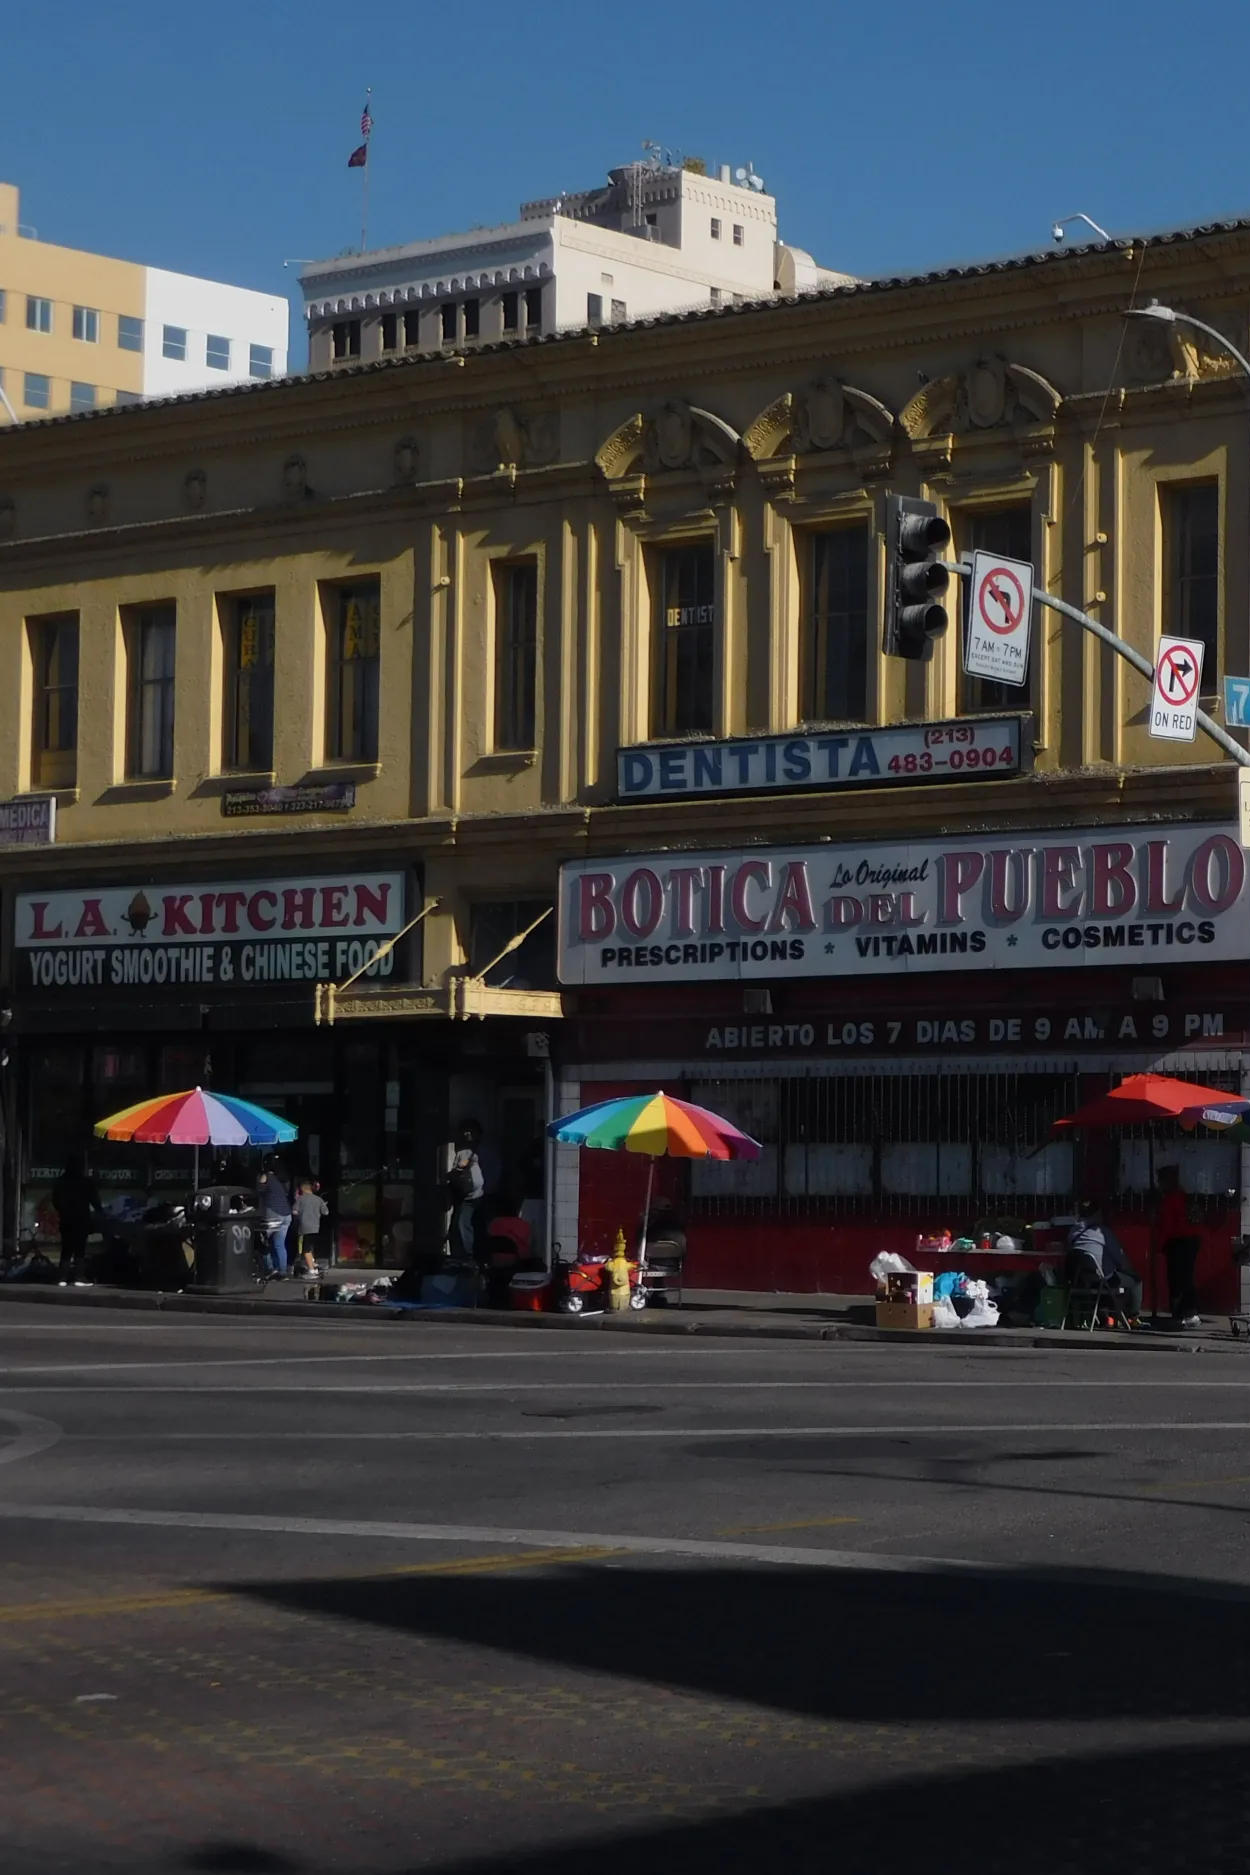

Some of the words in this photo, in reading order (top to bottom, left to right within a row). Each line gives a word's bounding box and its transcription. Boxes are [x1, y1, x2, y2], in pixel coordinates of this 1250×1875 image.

[667, 604, 714, 627] DENTIST
[981, 640, 995, 653] AM
[1009, 646, 1022, 659] PM
[923, 727, 976, 749] (213)
[1154, 712, 1170, 728] ON
[1172, 714, 1193, 731] RED
[623, 736, 881, 793] DENTISTA
[887, 746, 1015, 775] 483-0904
[855, 858, 930, 890] Original
[941, 833, 1245, 922] PUEBLO
[161, 882, 393, 936] KITCHEN
[577, 858, 819, 942] BOTICA
[830, 891, 929, 928] DEL
[29, 949, 107, 987] YOGURT
[110, 945, 214, 984] SMOOTHIE
[219, 949, 235, 981] &
[240, 942, 331, 980] CHINESE
[335, 938, 395, 976] FOOD
[600, 939, 806, 969] PRESCRIPTIONS
[856, 930, 987, 959] VITAMINS
[1041, 919, 1216, 951] COSMETICS
[705, 1024, 815, 1049] ABIERTO
[827, 1022, 875, 1046] LOS
[887, 1021, 902, 1044] 7
[916, 1019, 976, 1043] DIAS
[989, 1018, 1021, 1041] DE
[1034, 1017, 1051, 1041] 9
[1118, 1015, 1138, 1038] A
[1151, 1013, 1169, 1037] 9
[1184, 1013, 1224, 1037] PM
